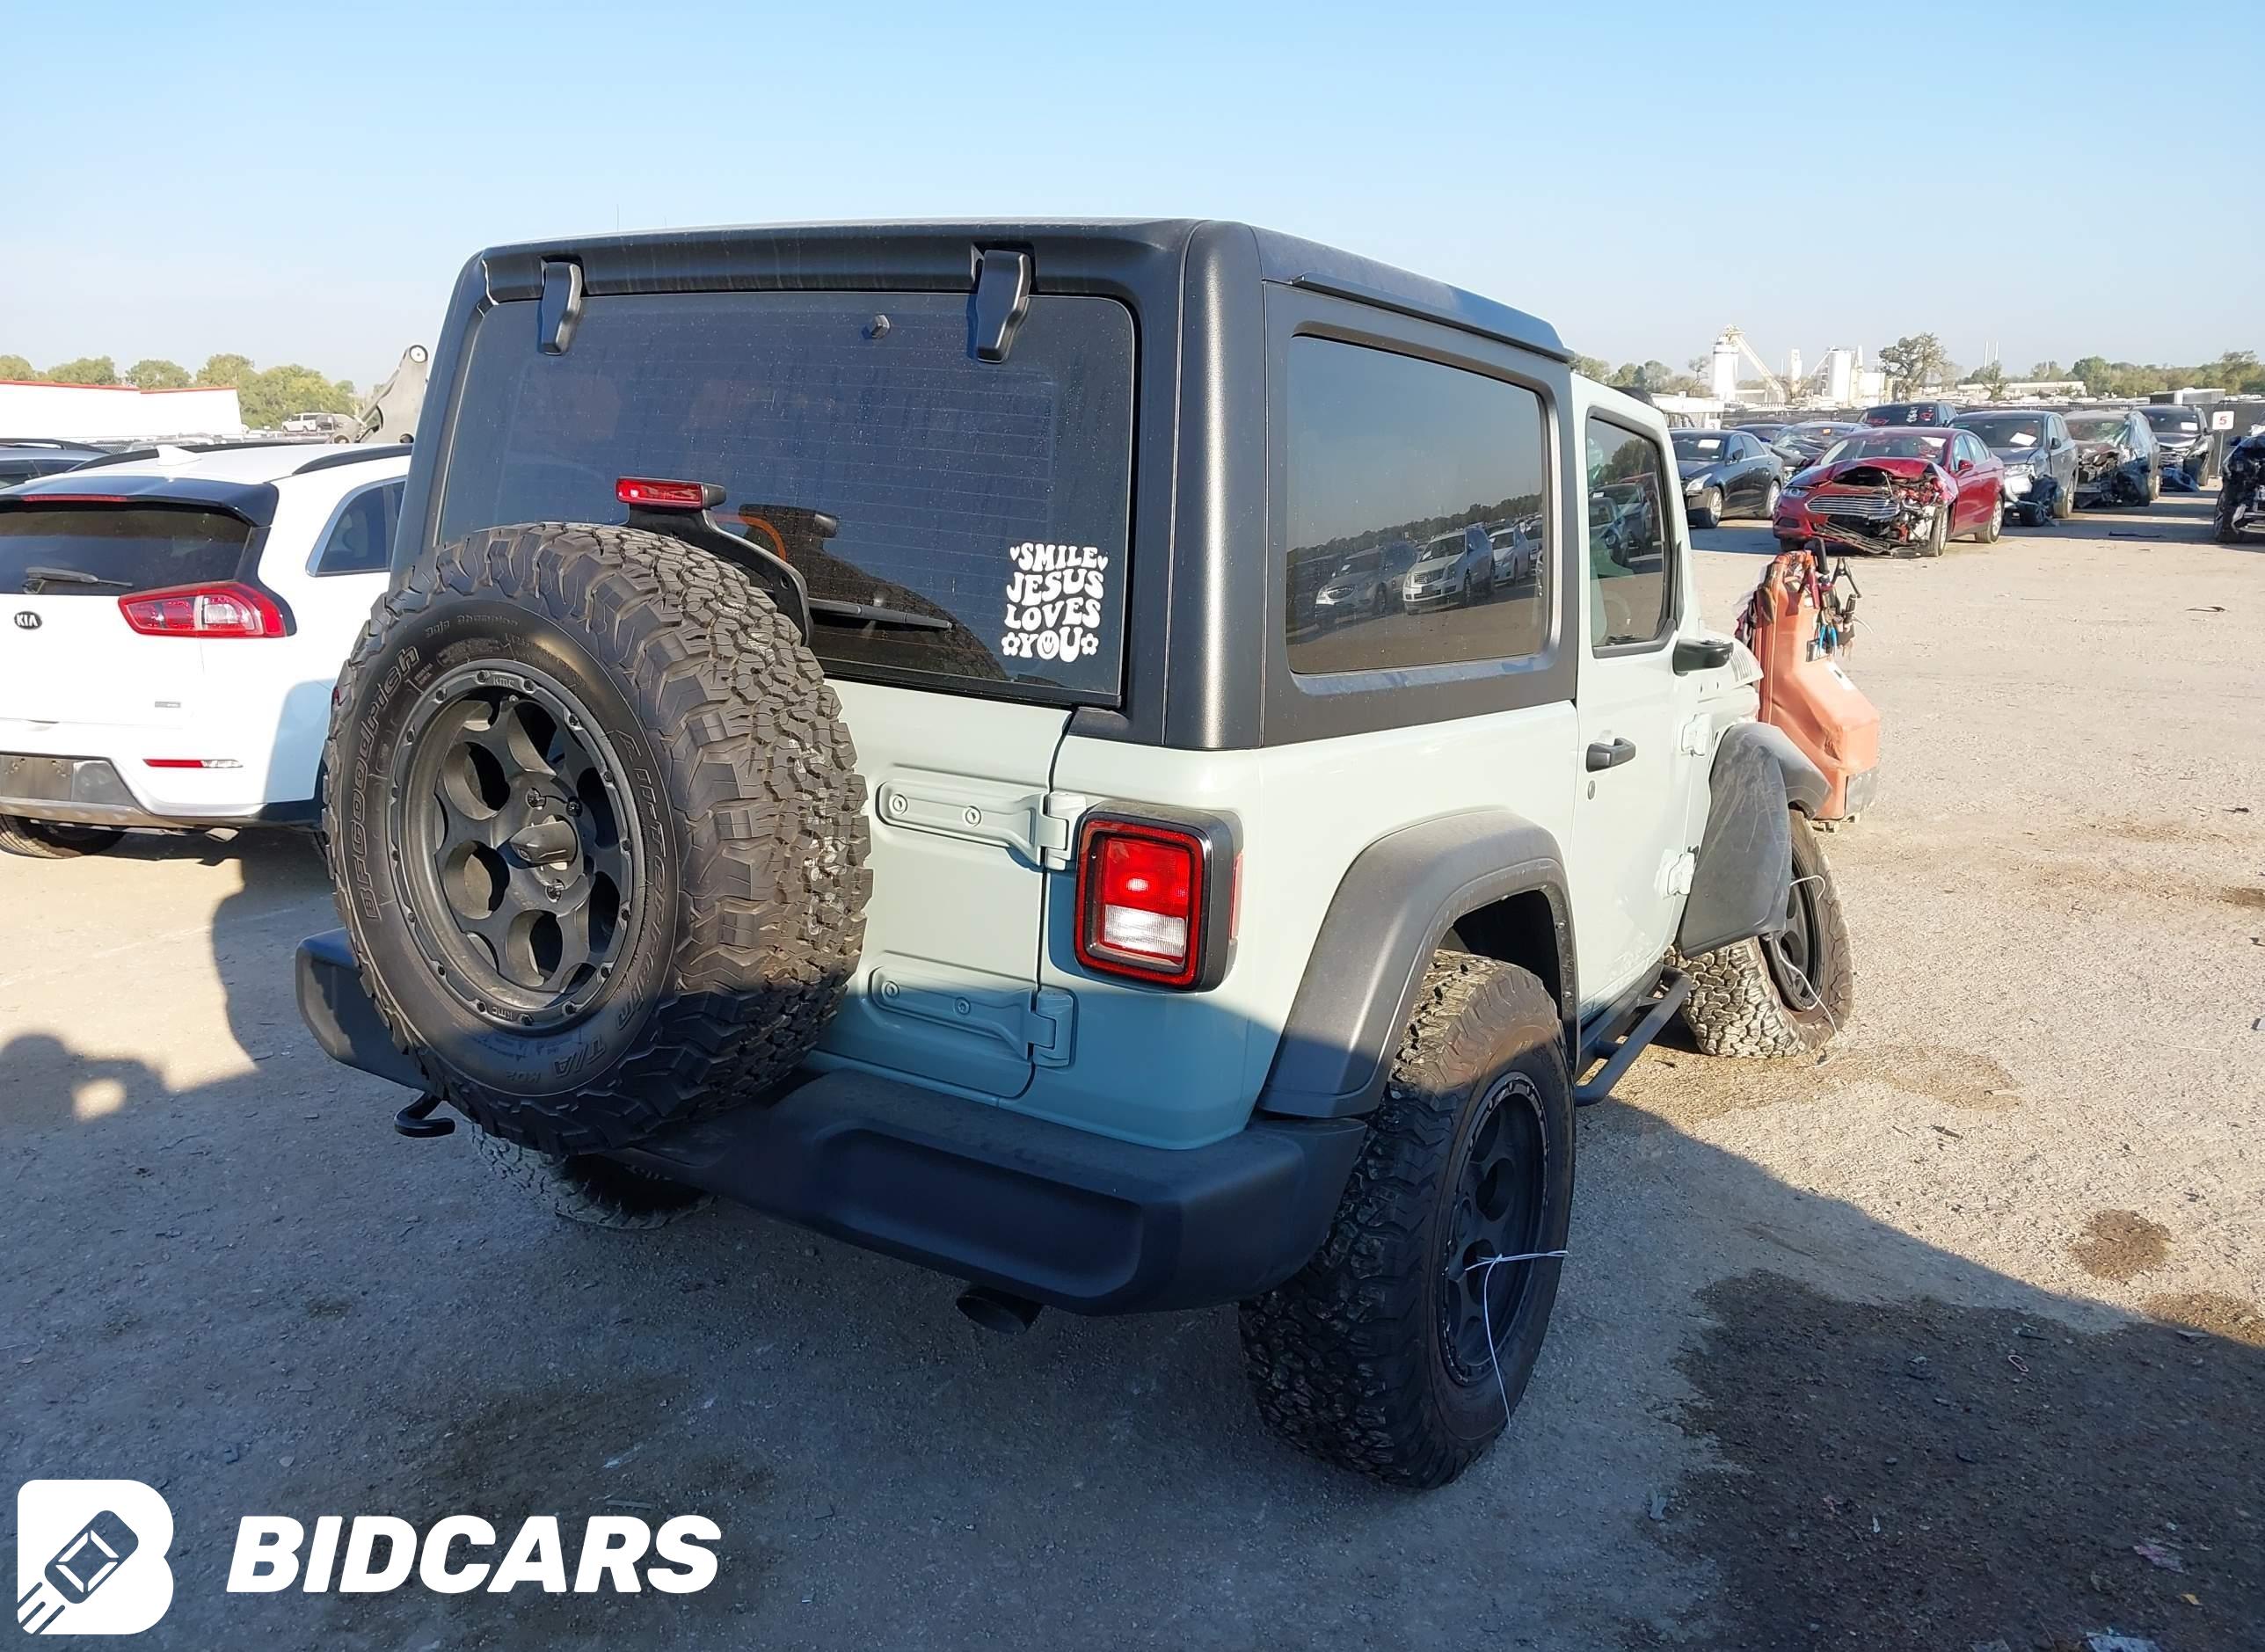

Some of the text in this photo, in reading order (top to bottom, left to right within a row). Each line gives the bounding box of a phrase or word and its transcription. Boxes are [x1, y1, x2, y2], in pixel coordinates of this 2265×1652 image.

[2218, 415, 2227, 426] 5
[1018, 542, 1098, 571] SMILE
[1006, 568, 1104, 606] JESUS
[16, 614, 39, 627] KIA
[1004, 597, 1101, 631] LOVES
[1018, 626, 1083, 663] YOU
[351, 645, 419, 921] BFGoodrich
[553, 1034, 607, 1077] T/A
